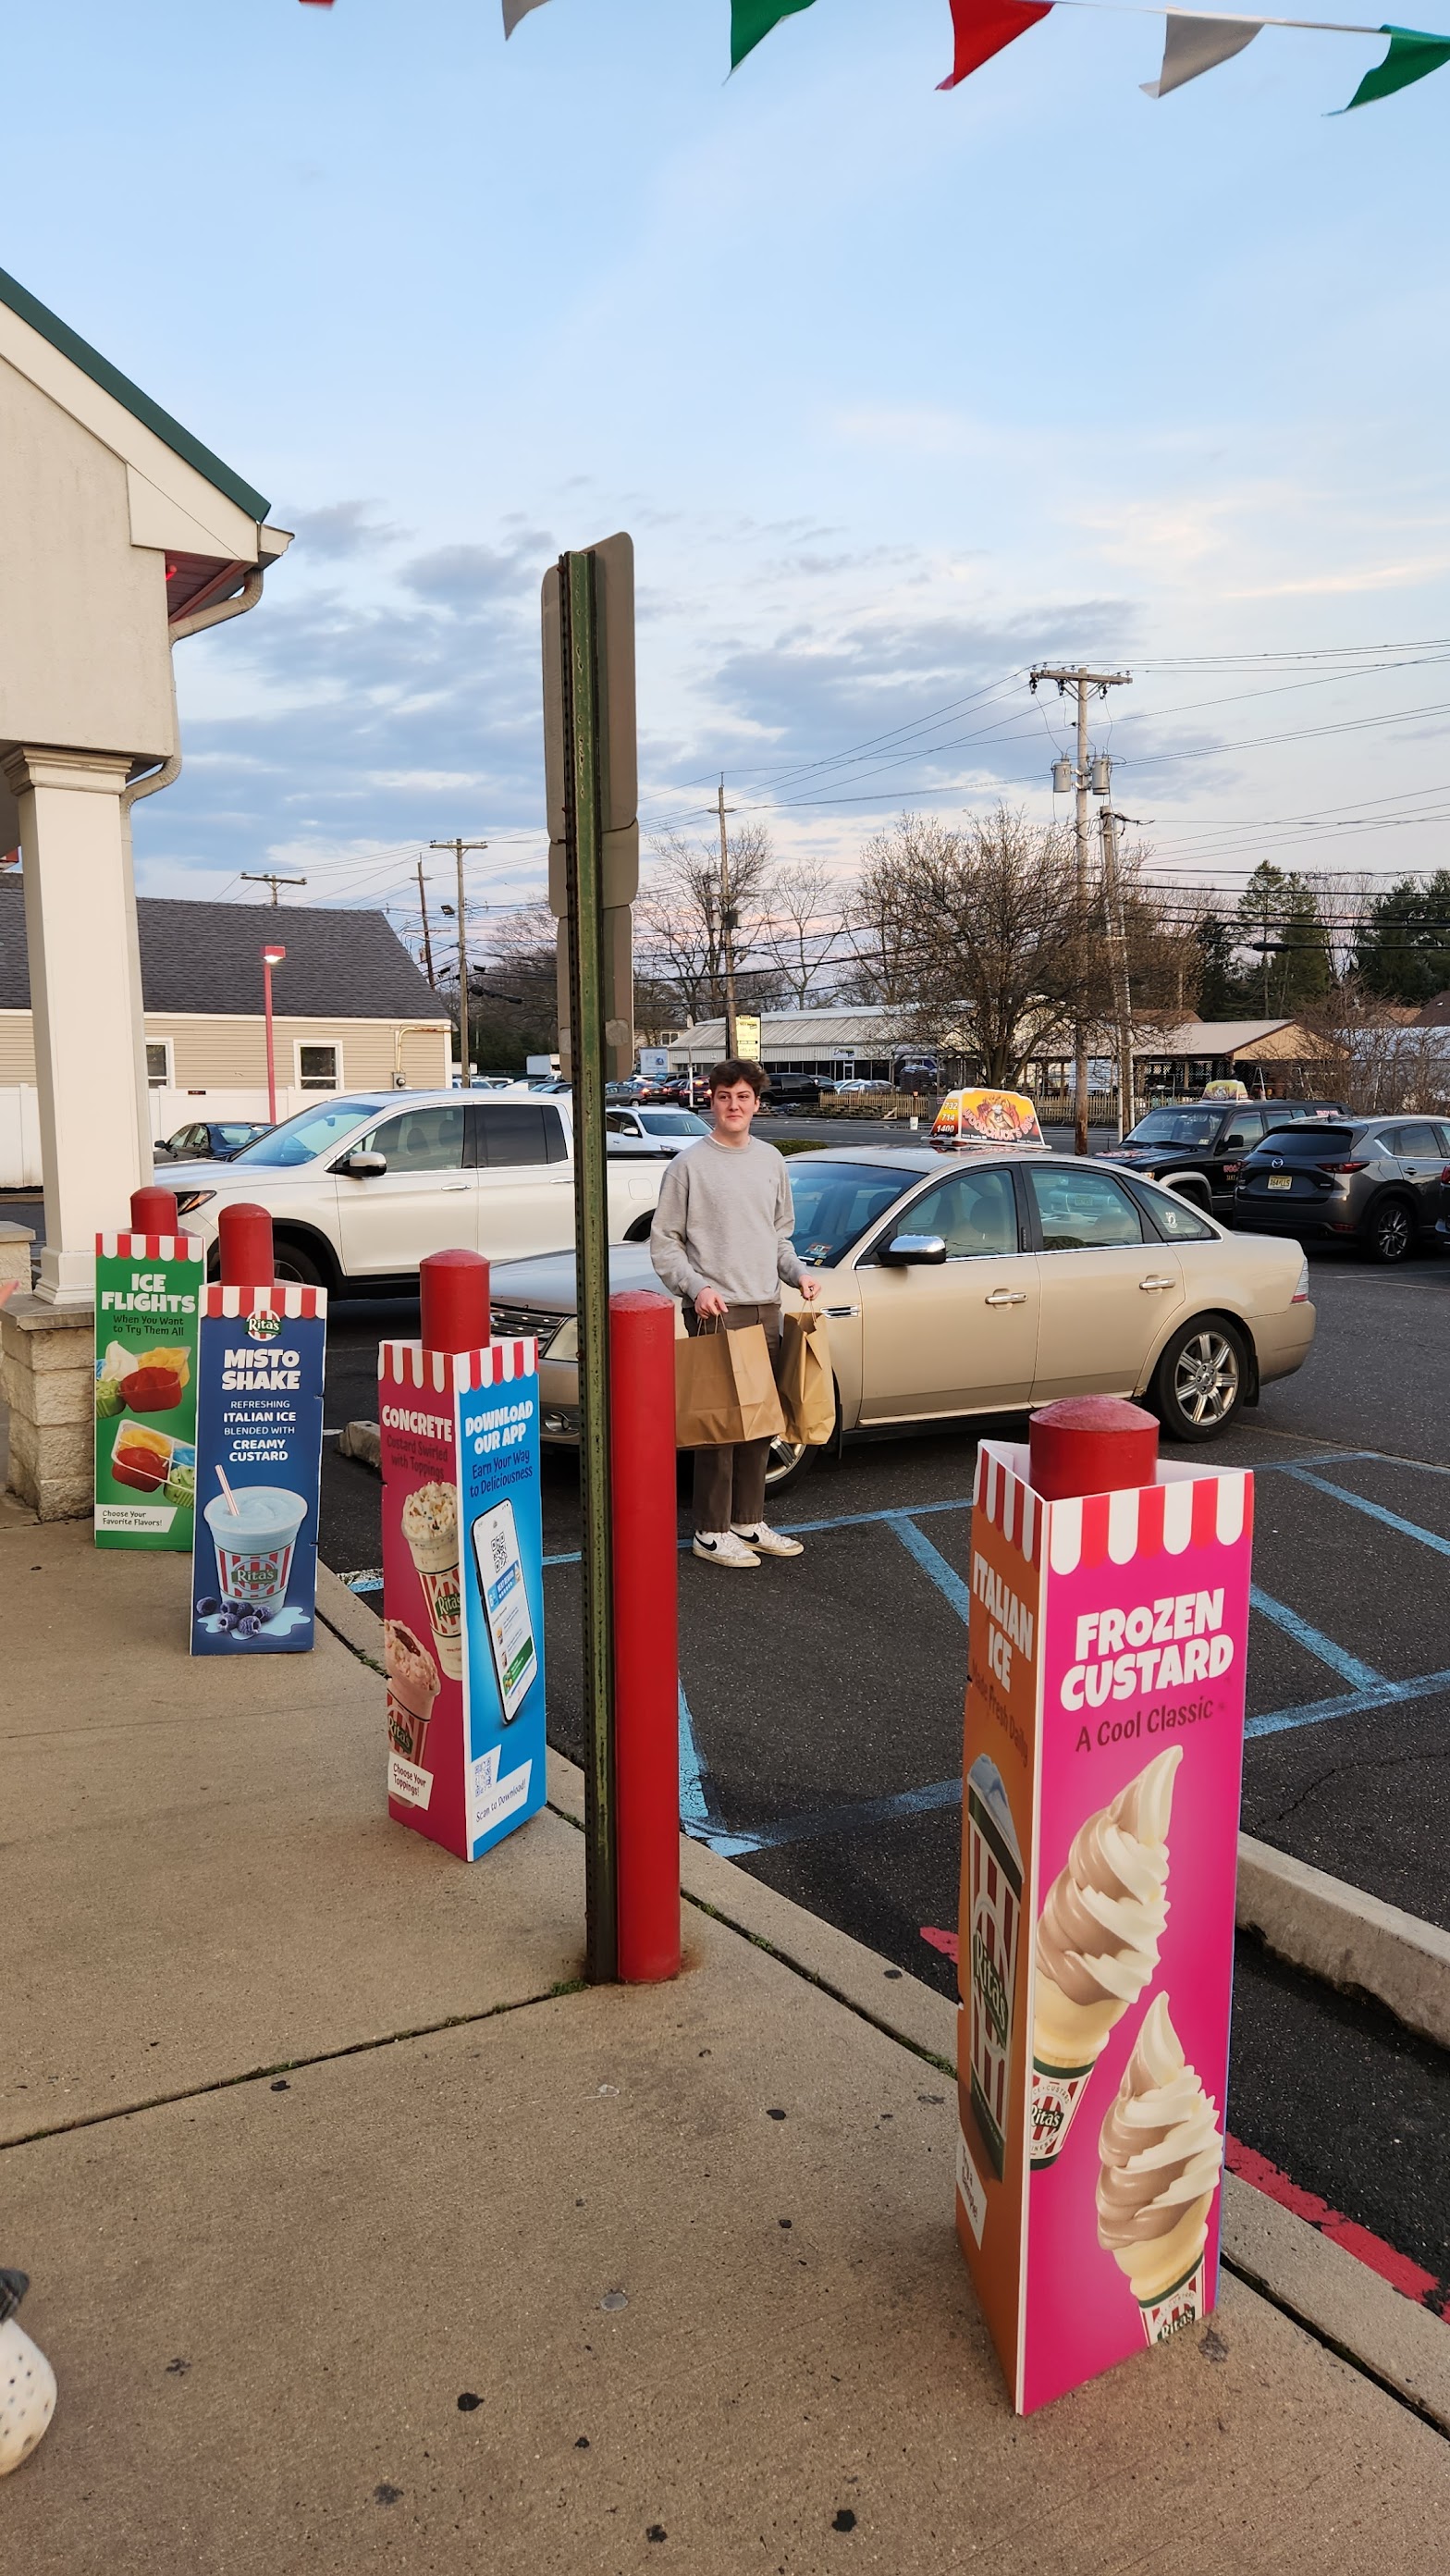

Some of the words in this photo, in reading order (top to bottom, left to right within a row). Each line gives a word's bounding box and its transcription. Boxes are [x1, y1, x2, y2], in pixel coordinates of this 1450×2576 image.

[937, 1125, 954, 1133] 1400
[131, 1273, 166, 1293] ICE
[102, 1291, 196, 1313] FLIGHTS
[113, 1314, 139, 1324] When
[141, 1315, 157, 1325] You
[160, 1317, 184, 1325] Want
[126, 1325, 141, 1336] Try
[144, 1325, 169, 1335] Them
[171, 1327, 184, 1336] All
[249, 1318, 280, 1331] Rita's
[224, 1349, 301, 1369] MISTO
[222, 1370, 301, 1390] SHAKE
[231, 1400, 290, 1409] REFRESHING
[223, 1412, 273, 1423] ITALIAN
[276, 1411, 296, 1422] ICE
[382, 1405, 452, 1442] CONCRETE
[465, 1400, 534, 1437] DOWNLOAD
[224, 1427, 268, 1436] BLENDED
[474, 1430, 500, 1455] OUR
[502, 1422, 526, 1447] APP
[229, 1451, 289, 1461] CUSTARD
[233, 1439, 286, 1450] CREAMY
[387, 1435, 416, 1453] Custard
[418, 1441, 448, 1461] Swirled
[391, 1453, 408, 1469] with
[410, 1456, 444, 1480] Toppings
[472, 1463, 491, 1480] Earn
[494, 1455, 511, 1473] Your
[513, 1449, 530, 1465] Way
[470, 1485, 479, 1498] to
[481, 1466, 533, 1495] Deliciousness
[238, 1569, 274, 1582] Rita's
[437, 1594, 461, 1614] Rita's
[972, 1550, 1033, 1661] ITALIAN
[1075, 1588, 1225, 1661] FROZEN
[988, 1623, 1013, 1693] ICE
[1060, 1633, 1235, 1712] CUSTARD
[388, 1715, 410, 1748] Rita's
[989, 1684, 1008, 1732] Fresh
[1009, 1714, 1028, 1768] Daily
[1075, 1726, 1092, 1753] A
[1097, 1713, 1141, 1747] Cool
[1148, 1695, 1214, 1734] Classic
[393, 1763, 412, 1781] Choose
[413, 1773, 426, 1787] Your
[393, 1774, 420, 1796] Toppings!
[476, 1807, 489, 1823] Scan
[491, 1802, 498, 1811] to
[498, 1778, 526, 1806] Download!
[977, 1929, 1005, 2029] Rita's
[1047, 2085, 1070, 2104] CUSTARD
[1031, 2104, 1061, 2127] Rita's
[1161, 2309, 1193, 2338] Rita's
